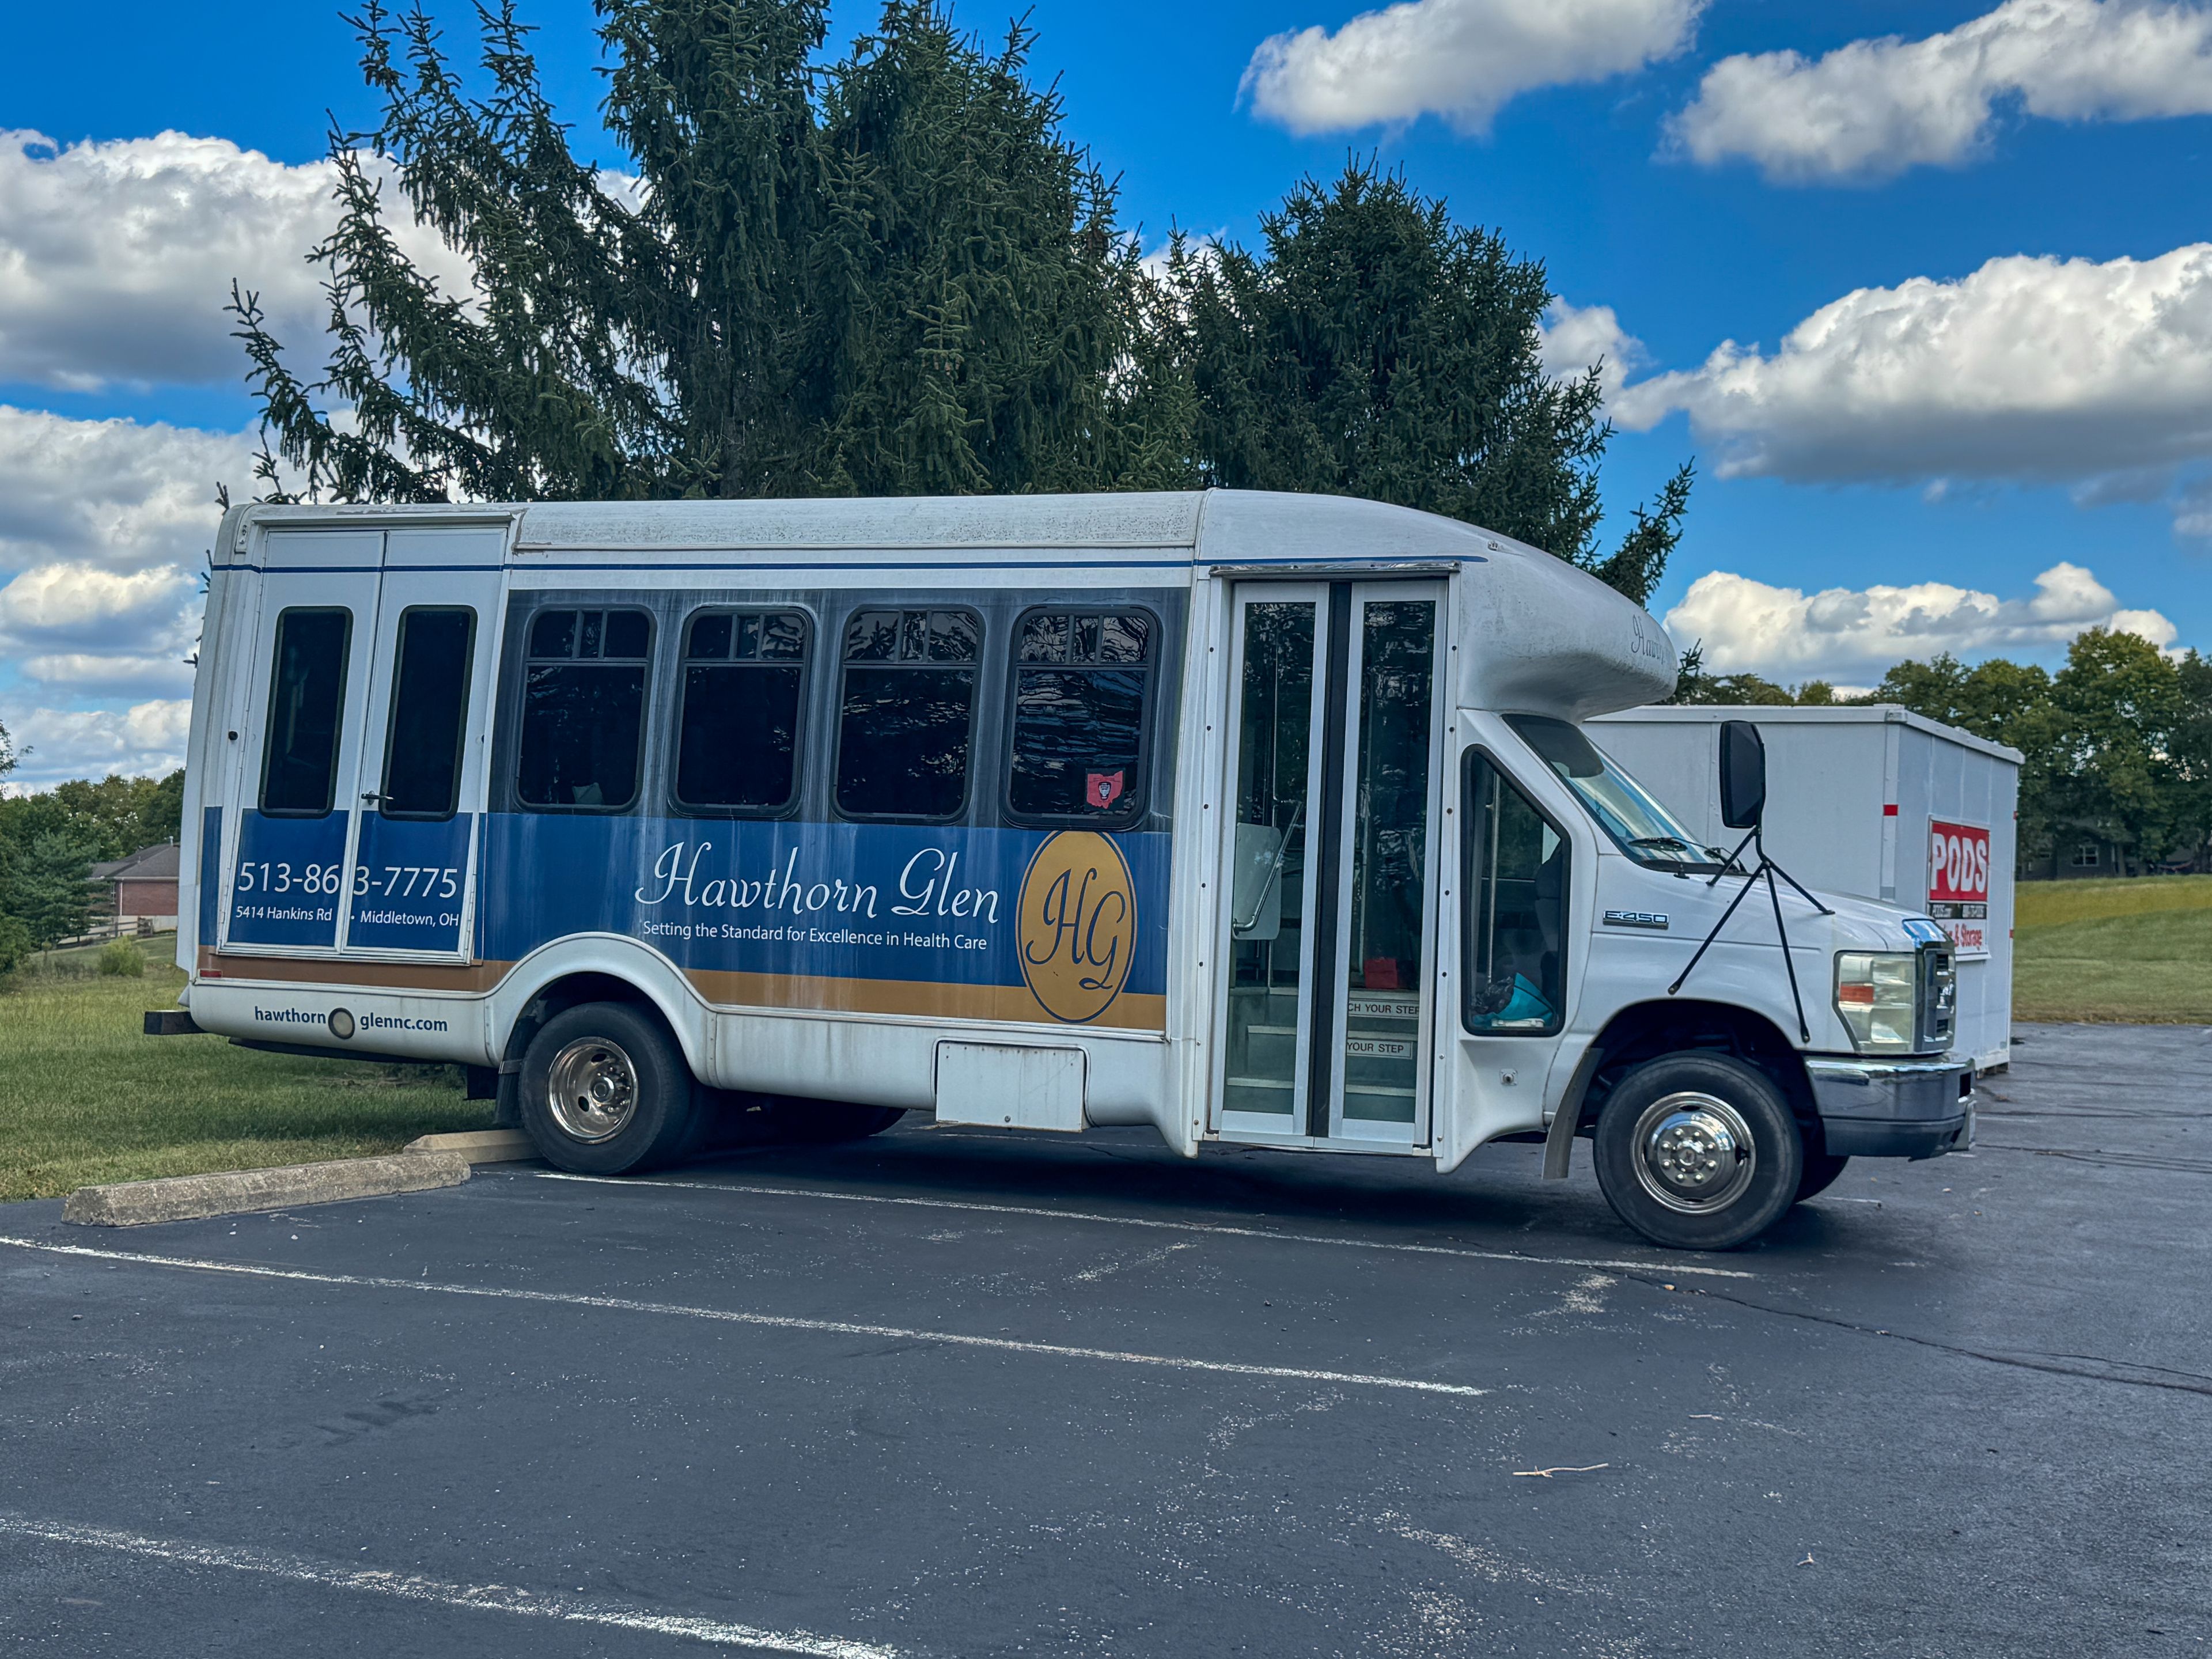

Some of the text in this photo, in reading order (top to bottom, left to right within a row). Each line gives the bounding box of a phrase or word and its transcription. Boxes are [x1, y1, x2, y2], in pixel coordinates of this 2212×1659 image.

[1931, 832, 1987, 893] PODS
[238, 862, 458, 898] 513-863-7775
[635, 842, 999, 924] Hawthorn Glen
[236, 906, 332, 921] 5414 Hankins Rd
[360, 911, 459, 927] Middletown, OH
[643, 921, 987, 950] Setting the Standard for Excellence in Health Care
[1961, 923, 1982, 951] Storage
[254, 1006, 448, 1032] hawthorn glennc.com
[1365, 1004, 1391, 1013] YOUR
[1347, 1043, 1404, 1053] YOUR STEP
